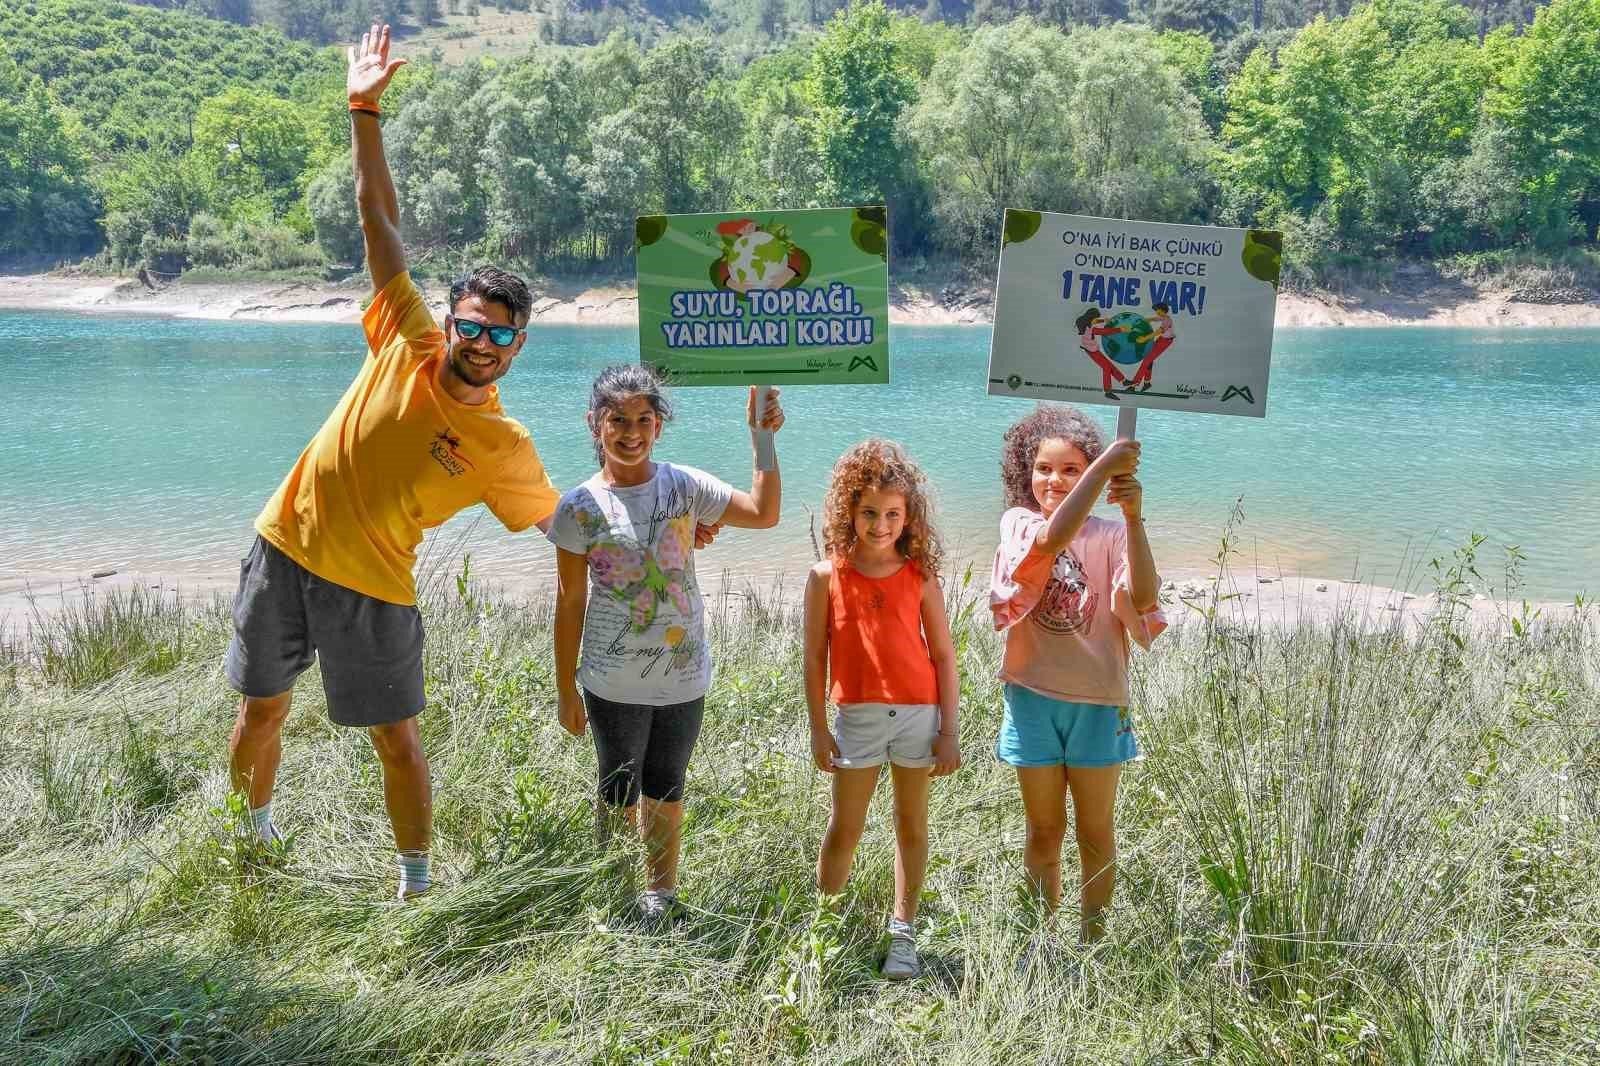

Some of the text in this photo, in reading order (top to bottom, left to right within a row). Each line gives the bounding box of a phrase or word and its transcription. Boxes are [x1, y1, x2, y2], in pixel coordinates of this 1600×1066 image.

[1062, 230, 1223, 257] O'NA İYİ BAK ÇÜNKÜ
[1074, 252, 1206, 276] O'NDAN SADECE
[672, 284, 861, 317] SUYU, TOPRAĞI,
[1062, 270, 1207, 316] 1 TANE VAR!
[663, 319, 874, 347] YARINLARI KORU!
